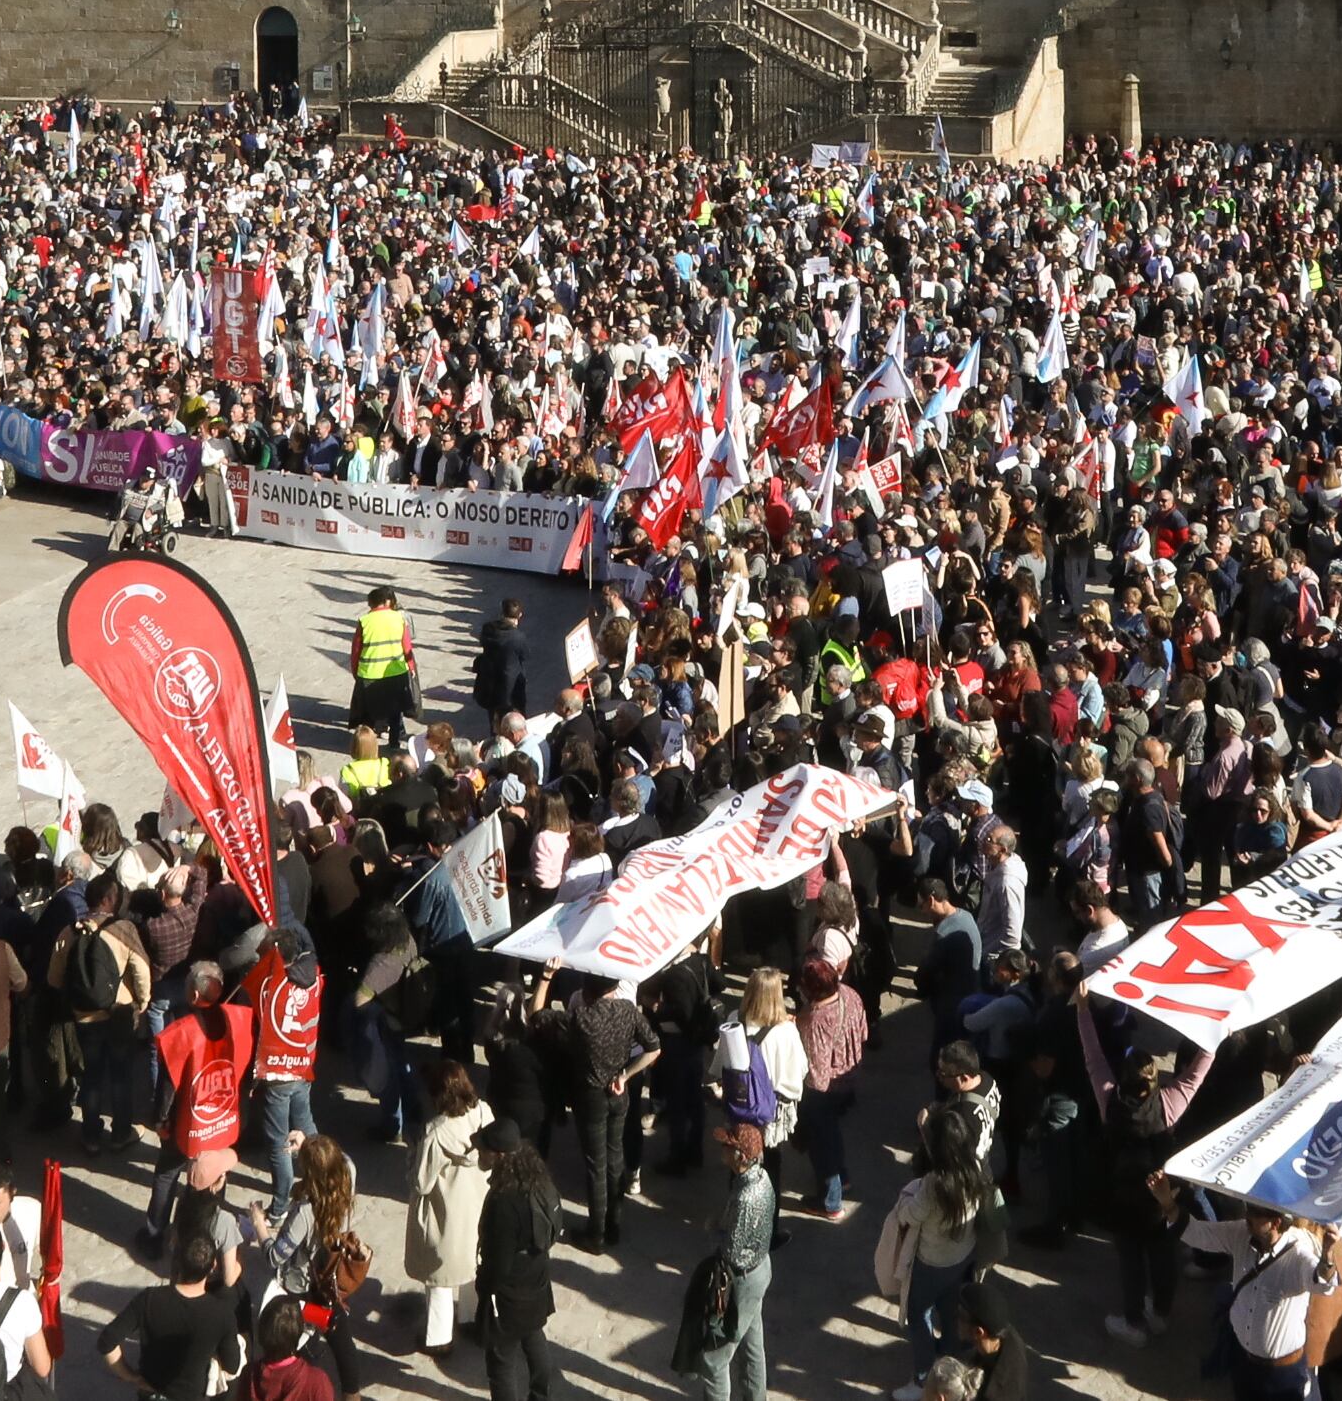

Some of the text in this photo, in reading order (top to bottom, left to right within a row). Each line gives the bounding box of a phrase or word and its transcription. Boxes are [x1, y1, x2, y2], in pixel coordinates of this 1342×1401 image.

[224, 272, 243, 354] UGT
[872, 465, 889, 487] PSOE
[881, 458, 895, 477] PSG
[262, 482, 343, 510] SANIDADE
[349, 492, 431, 519] PÚBLICA:
[436, 501, 449, 519] O
[455, 502, 500, 525] NOSO
[505, 506, 569, 531] DEREITO
[458, 850, 493, 926] esquerda unida
[1113, 893, 1311, 1022] XA!
[198, 1067, 234, 1094] UGT
[188, 1125, 213, 1138] mano
[1190, 1144, 1226, 1169] SEIXO
